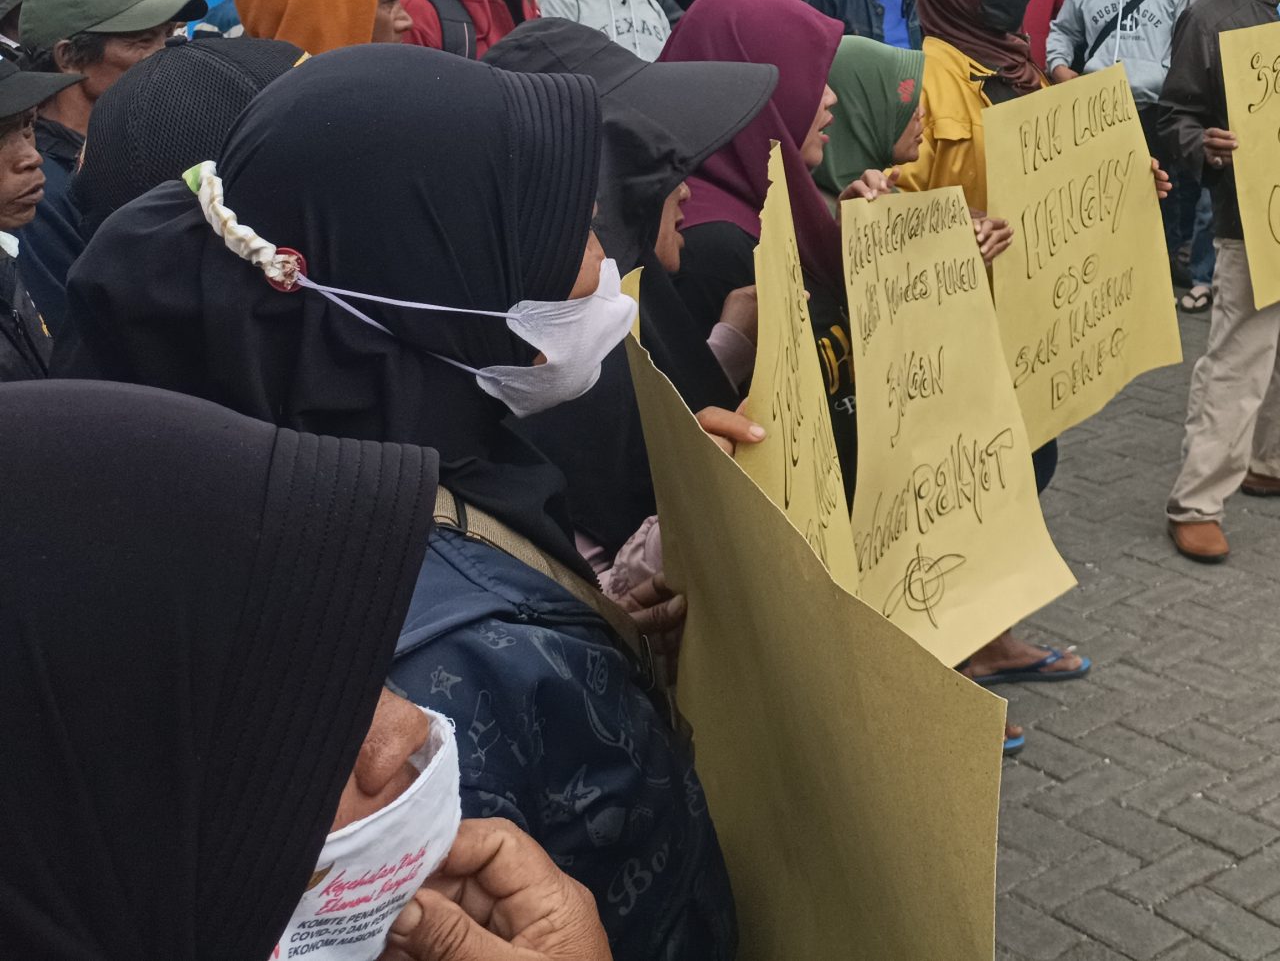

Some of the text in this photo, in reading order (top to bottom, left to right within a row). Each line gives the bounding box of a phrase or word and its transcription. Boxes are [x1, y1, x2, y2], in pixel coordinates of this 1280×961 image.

[1092, 2, 1121, 25] RUGB
[600, 17, 664, 42] TEXAS
[1019, 79, 1134, 175] PAK LURAH
[290, 921, 371, 943] COVID-19 DAN
[297, 915, 346, 930] KOMITE
[288, 938, 338, 959] EKONOMI
